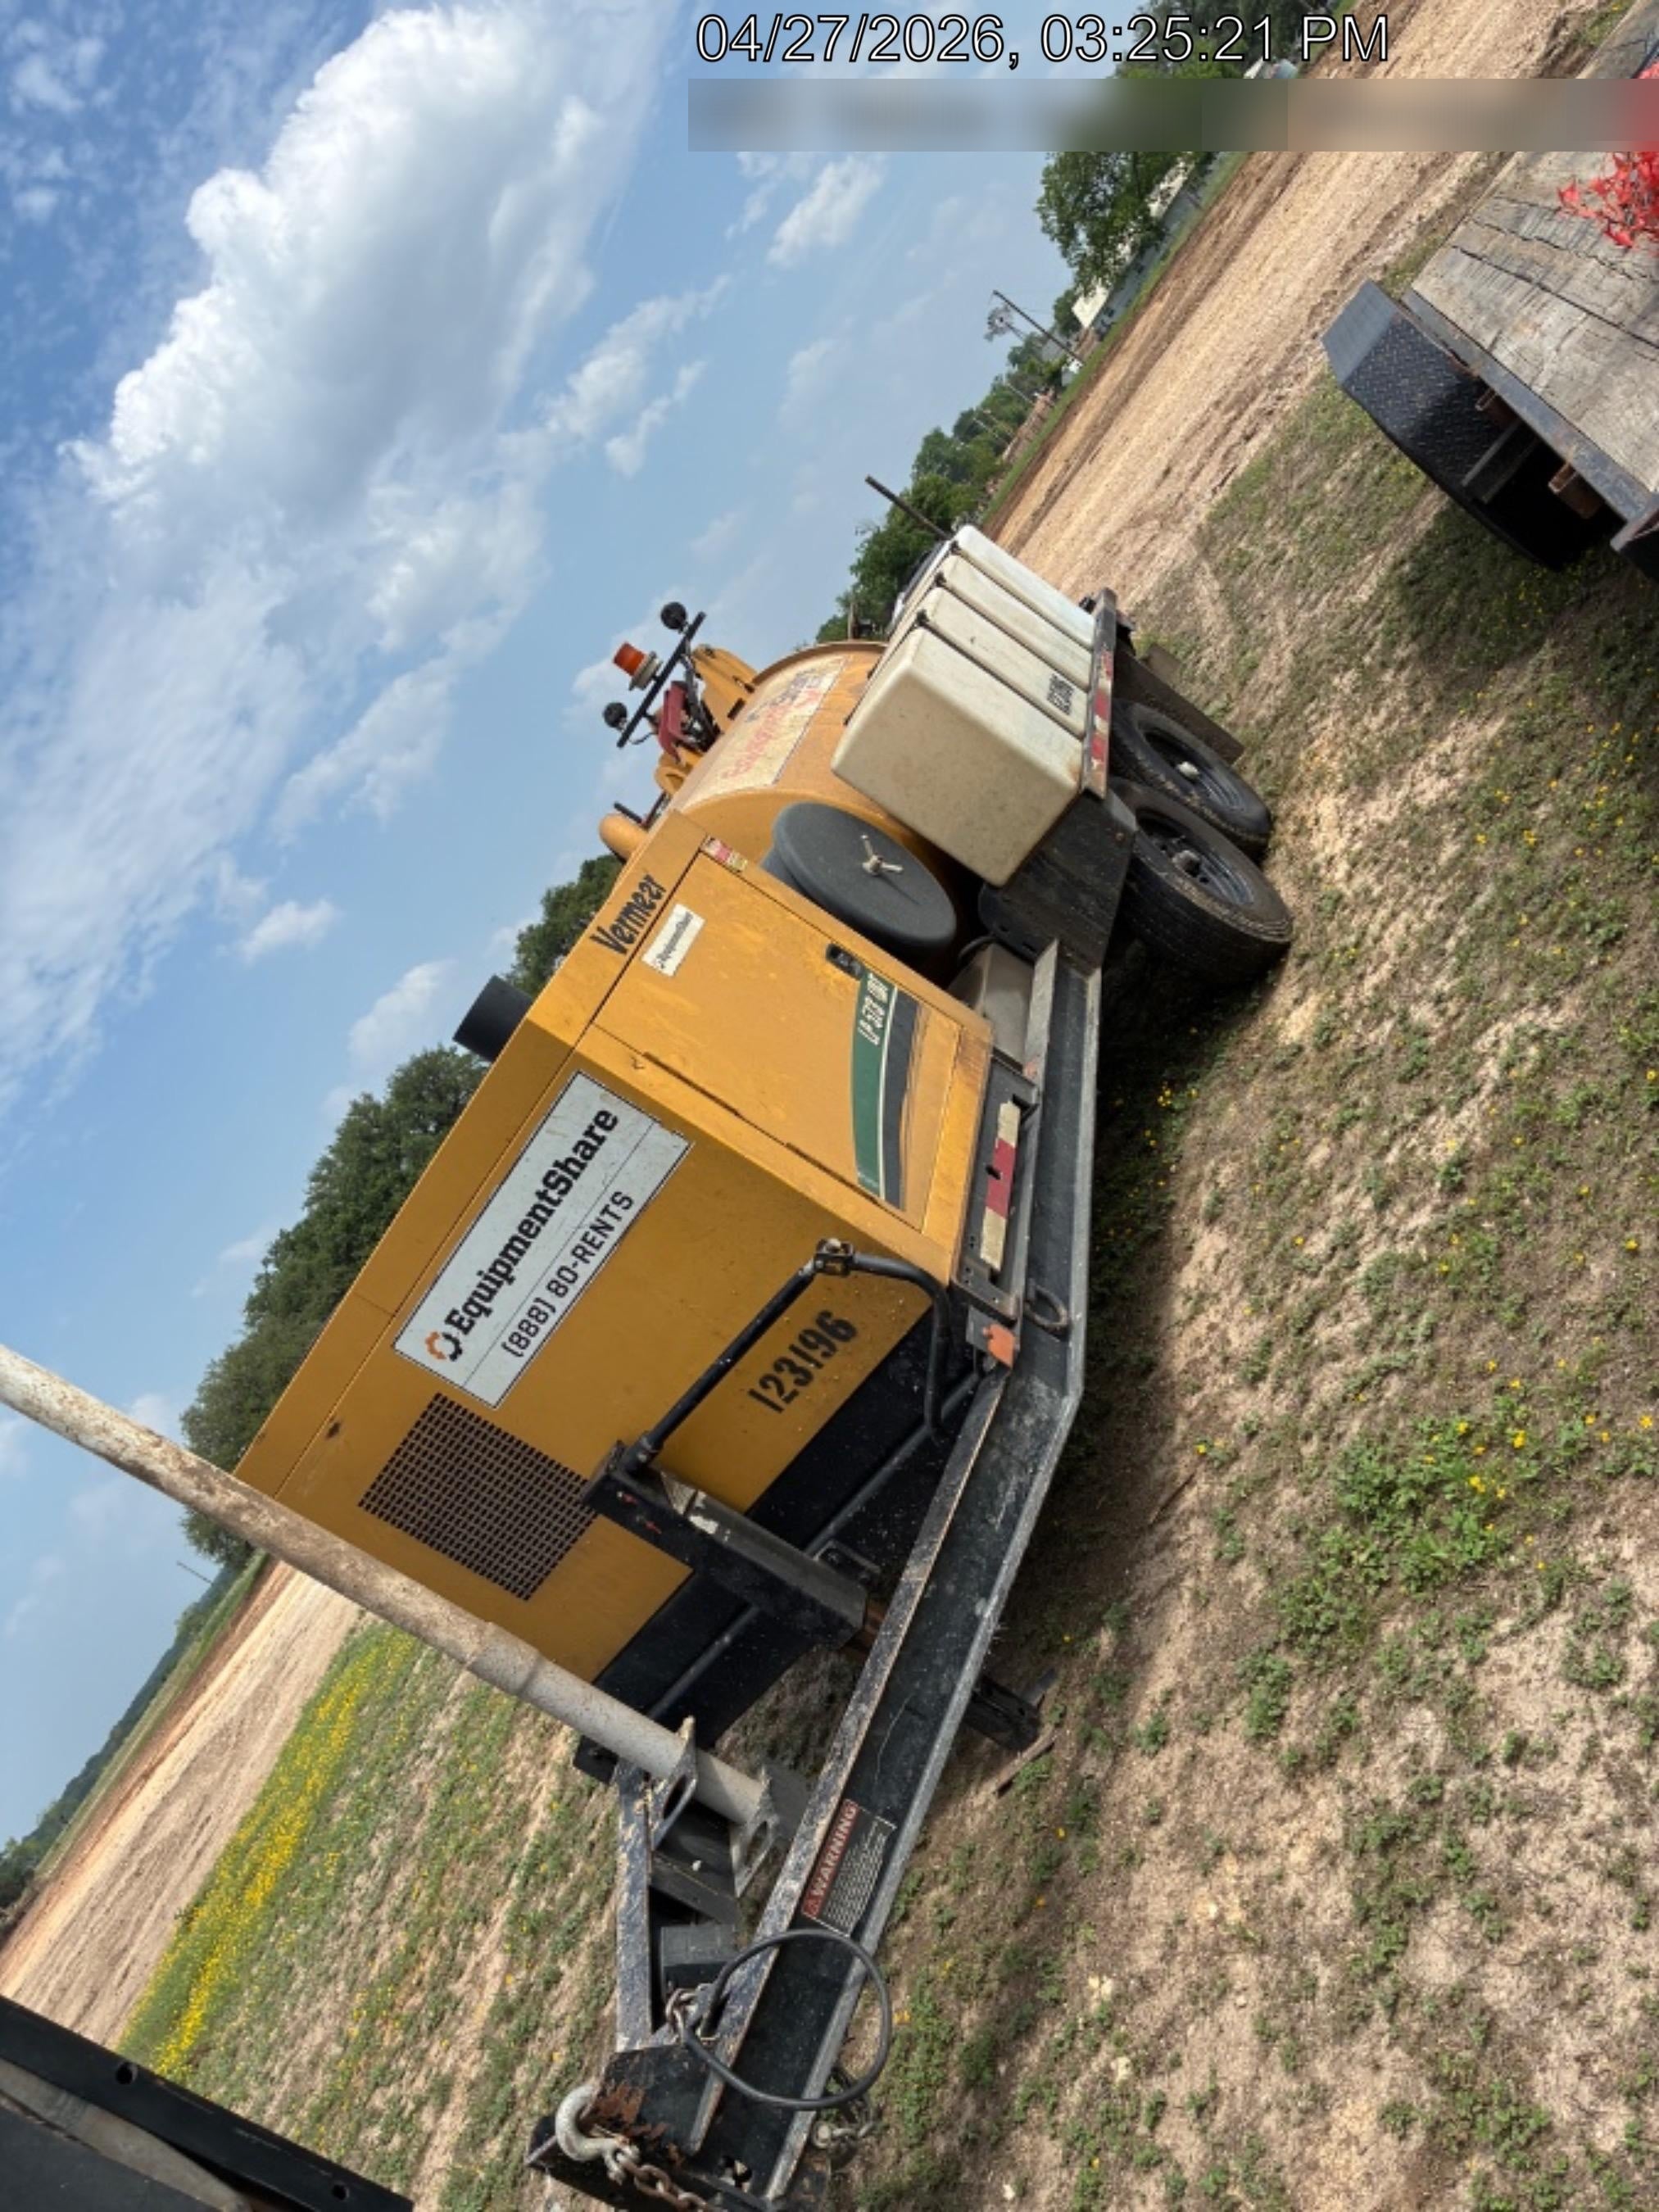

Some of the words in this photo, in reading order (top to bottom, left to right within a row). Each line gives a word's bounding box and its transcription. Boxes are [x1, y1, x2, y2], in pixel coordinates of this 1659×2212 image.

[590, 873, 667, 955] Vermeer
[445, 1108, 619, 1335] EquipmentShare
[501, 1296, 556, 1358] (888)
[546, 1190, 635, 1297] 80-RENTS
[748, 1309, 858, 1414] 123196
[812, 1802, 858, 1897] WARNING
